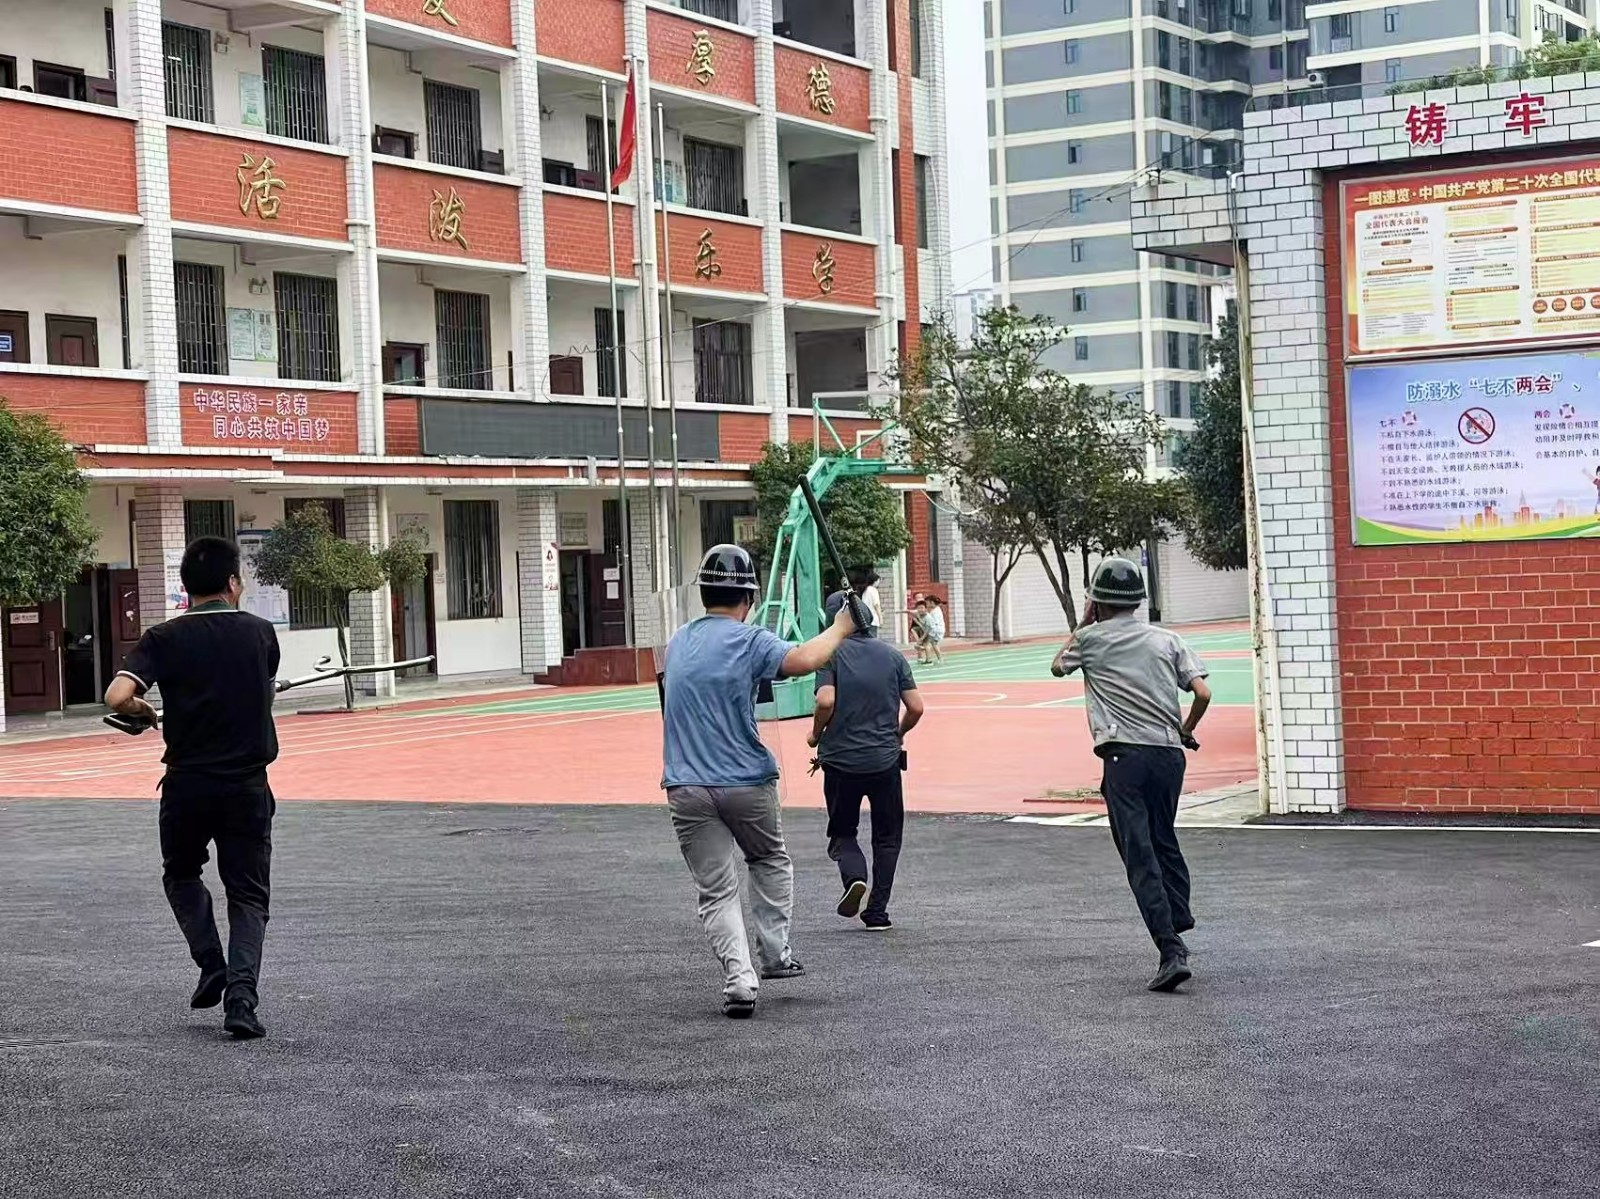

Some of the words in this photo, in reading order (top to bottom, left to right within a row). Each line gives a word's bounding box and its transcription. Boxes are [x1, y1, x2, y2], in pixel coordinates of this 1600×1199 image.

[686, 29, 716, 86] 厚
[804, 62, 836, 116] 德
[1405, 102, 1449, 148] 铸
[1504, 92, 1547, 138] 牢
[235, 153, 287, 220] 活
[1365, 216, 1429, 230] 全国代表大会报告
[695, 228, 722, 281] 乐
[812, 242, 837, 295] 学
[193, 388, 309, 416] 中华民族一家亲
[1534, 409, 1551, 419] 两会
[213, 415, 330, 441] 同心共筑中国梦
[1379, 418, 1397, 428] 七不
